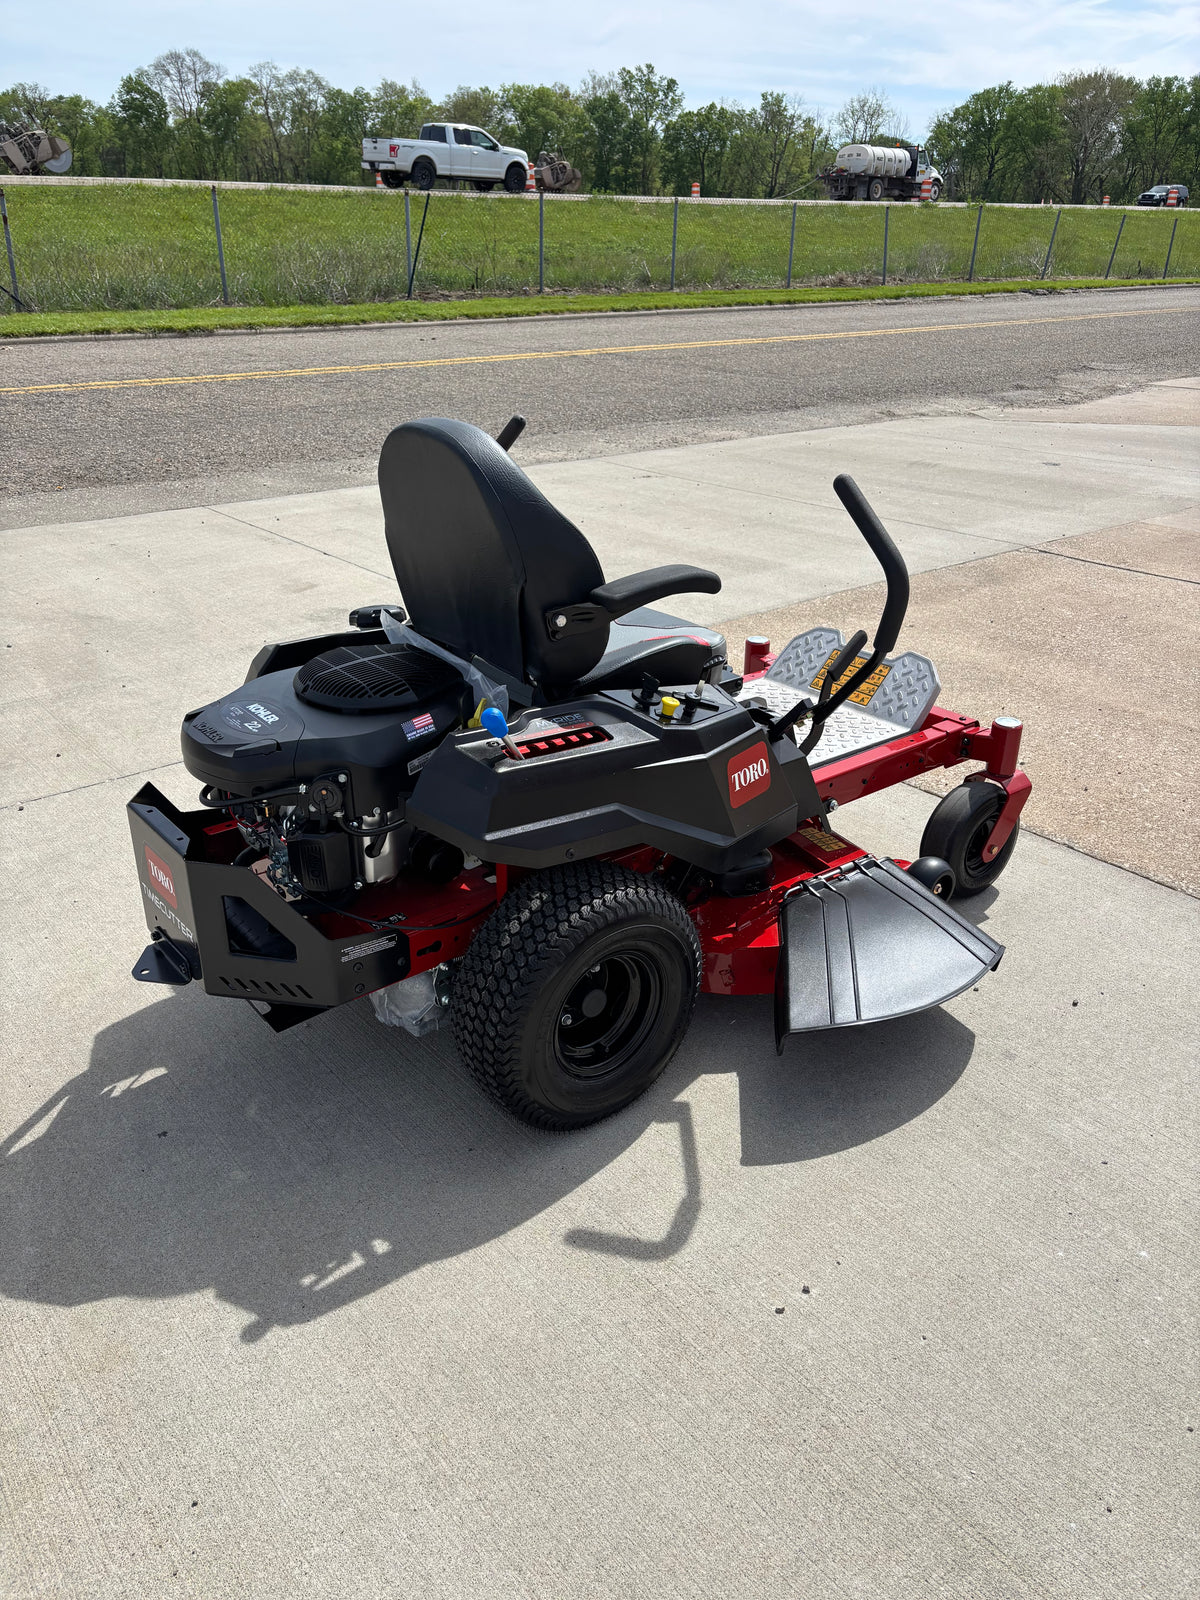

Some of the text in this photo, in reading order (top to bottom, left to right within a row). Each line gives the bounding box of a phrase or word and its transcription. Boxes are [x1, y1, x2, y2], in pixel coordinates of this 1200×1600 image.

[245, 703, 280, 725] KOHLER
[731, 758, 767, 792] TORO
[148, 859, 174, 894] TORO
[141, 881, 194, 943] TIMECUTTER
